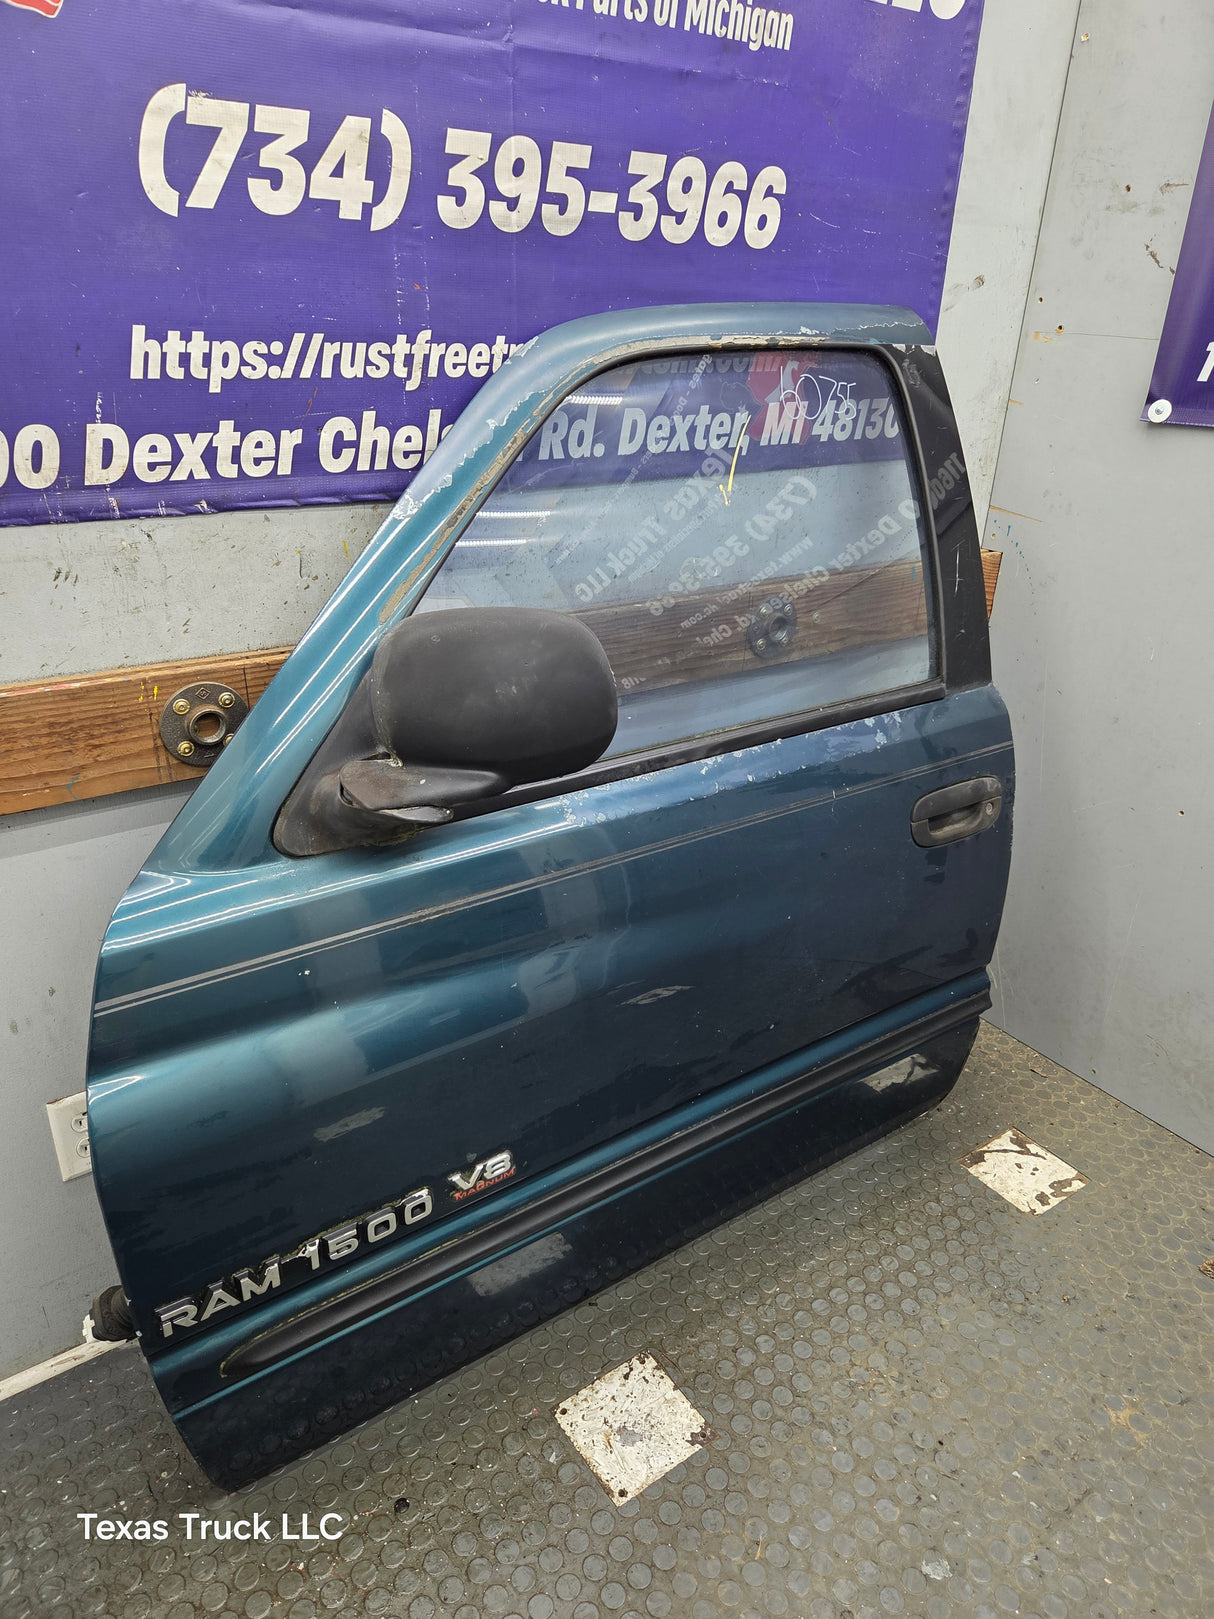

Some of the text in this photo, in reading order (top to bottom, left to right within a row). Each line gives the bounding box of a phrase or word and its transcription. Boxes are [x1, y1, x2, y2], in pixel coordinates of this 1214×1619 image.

[683, 0, 794, 51] Michigan
[138, 83, 787, 250] (734) 395-3966
[0, 422, 60, 490] 0
[84, 420, 303, 485] Dexter
[319, 409, 454, 473] Chel
[539, 402, 605, 461] Rd.
[617, 404, 750, 457] Dexter,
[760, 402, 809, 446] MI
[447, 1150, 513, 1190] V8
[451, 1168, 516, 1200] MAGNUM
[155, 1187, 433, 1338] RAM 1500
